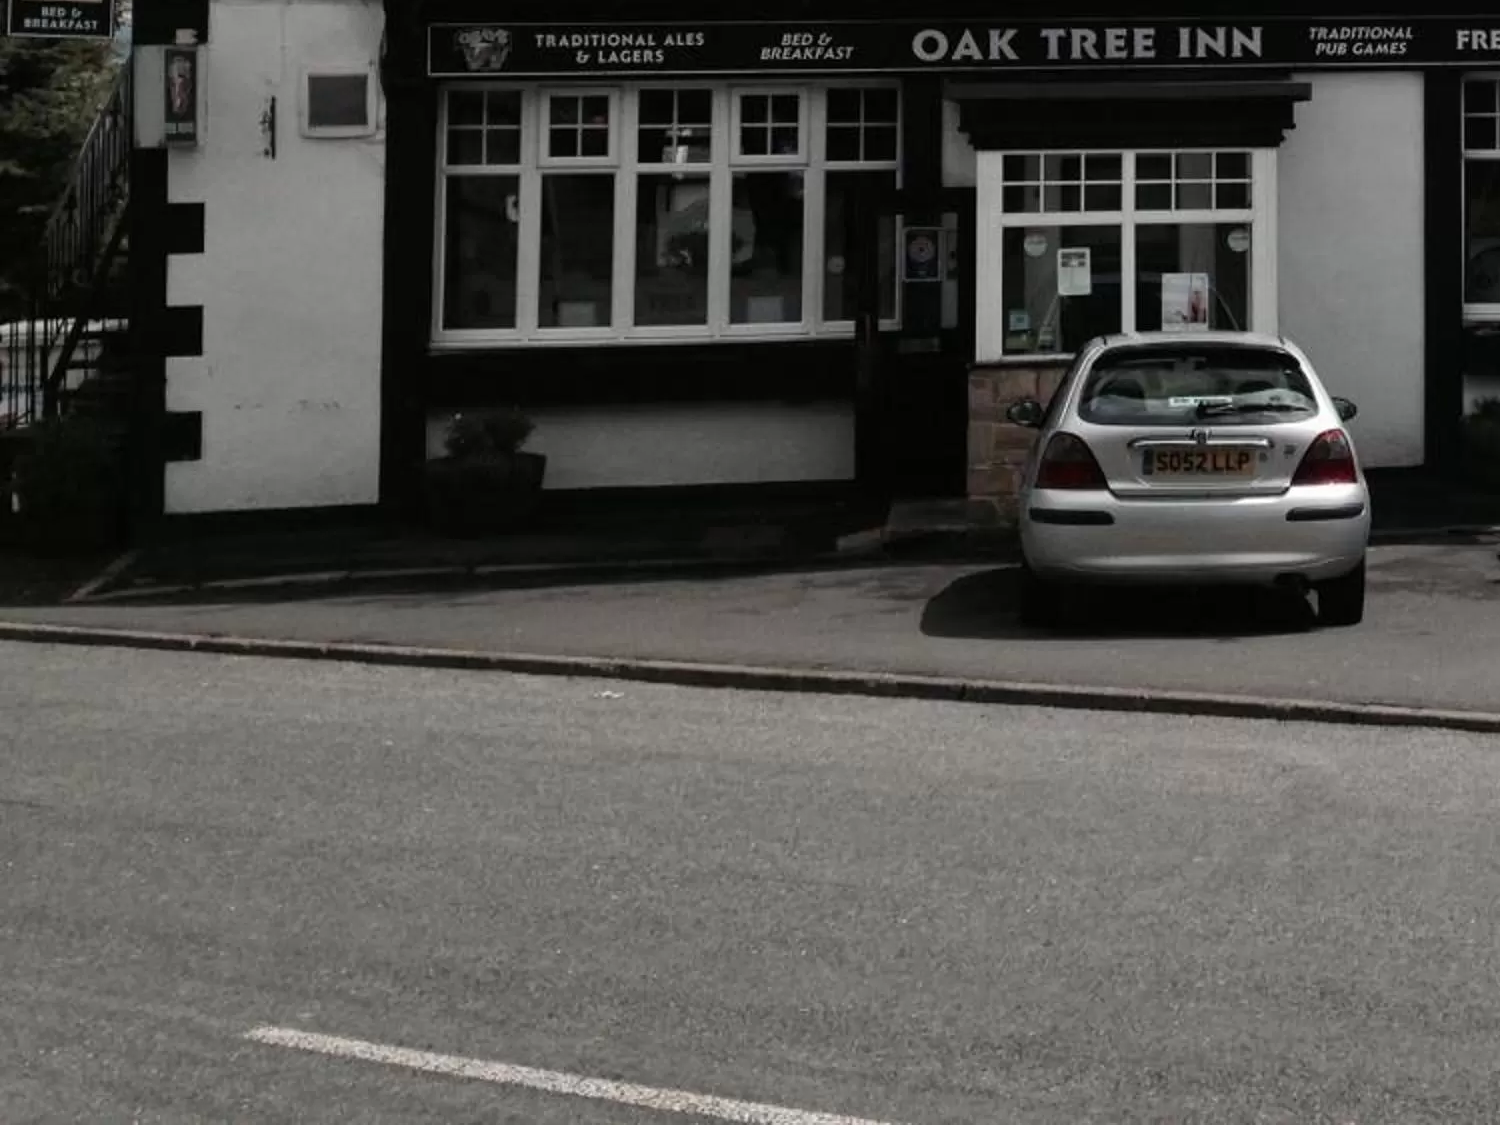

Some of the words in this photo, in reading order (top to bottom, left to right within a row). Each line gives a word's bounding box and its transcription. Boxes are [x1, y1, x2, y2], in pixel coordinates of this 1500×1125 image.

[41, 6, 65, 17] BED
[71, 7, 82, 17] &
[23, 18, 98, 30] BREAKFAST
[534, 33, 657, 48] TRADITIONAL
[663, 32, 705, 47] ALES
[780, 33, 814, 47] BED
[815, 32, 832, 46] &
[1309, 26, 1414, 40] TRADITIONAL
[911, 28, 1020, 62] OAK
[1040, 27, 1156, 60] TREE
[1178, 26, 1263, 59] INN
[1315, 42, 1347, 56] PUB
[1352, 42, 1408, 56] GAMES
[575, 50, 590, 64] &
[598, 49, 665, 64] LAGERS
[760, 46, 854, 61] BREAKFAST
[1156, 451, 1208, 474] SO52
[1212, 450, 1250, 472] LLP
